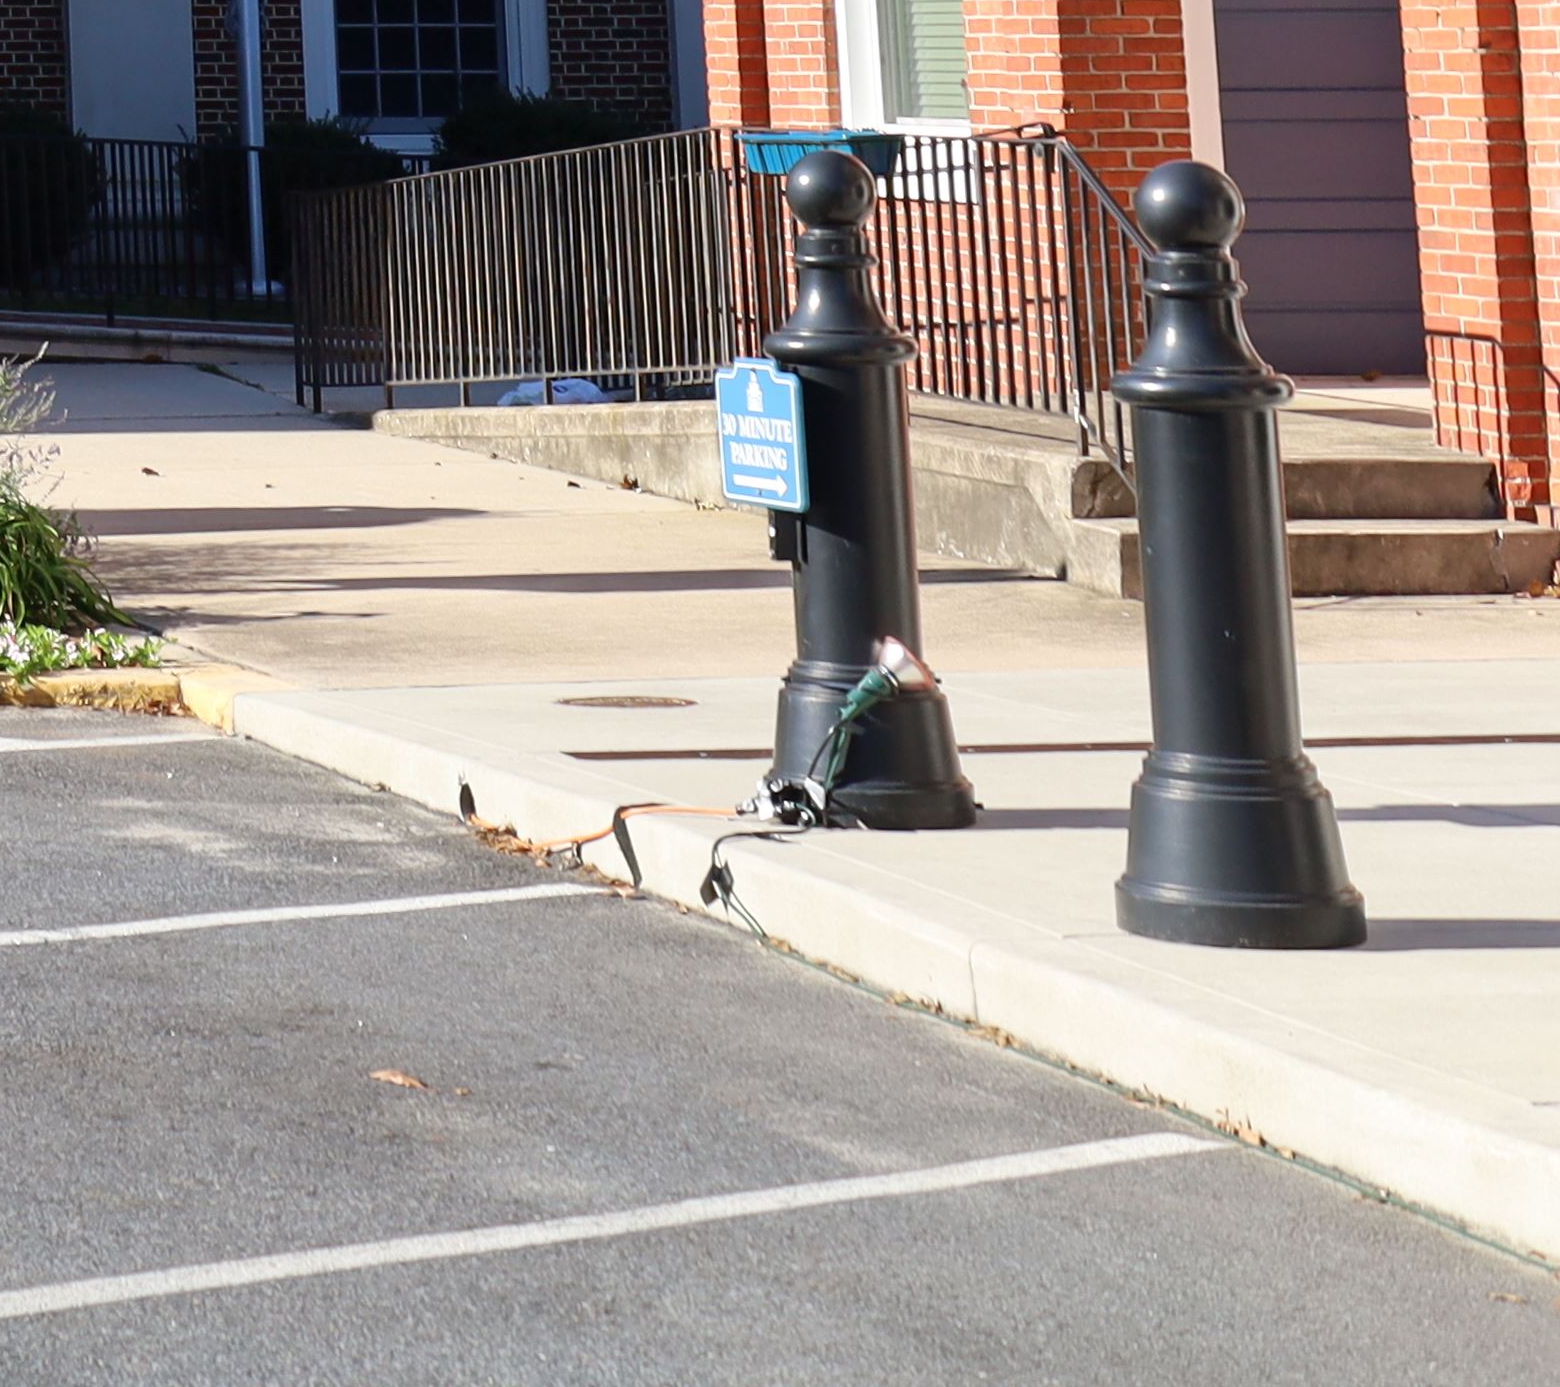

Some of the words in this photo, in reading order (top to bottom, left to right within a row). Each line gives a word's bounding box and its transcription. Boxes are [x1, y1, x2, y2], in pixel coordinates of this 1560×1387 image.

[722, 413, 737, 437] 30
[738, 414, 793, 444] MINUTE
[729, 441, 788, 471] PARKING
